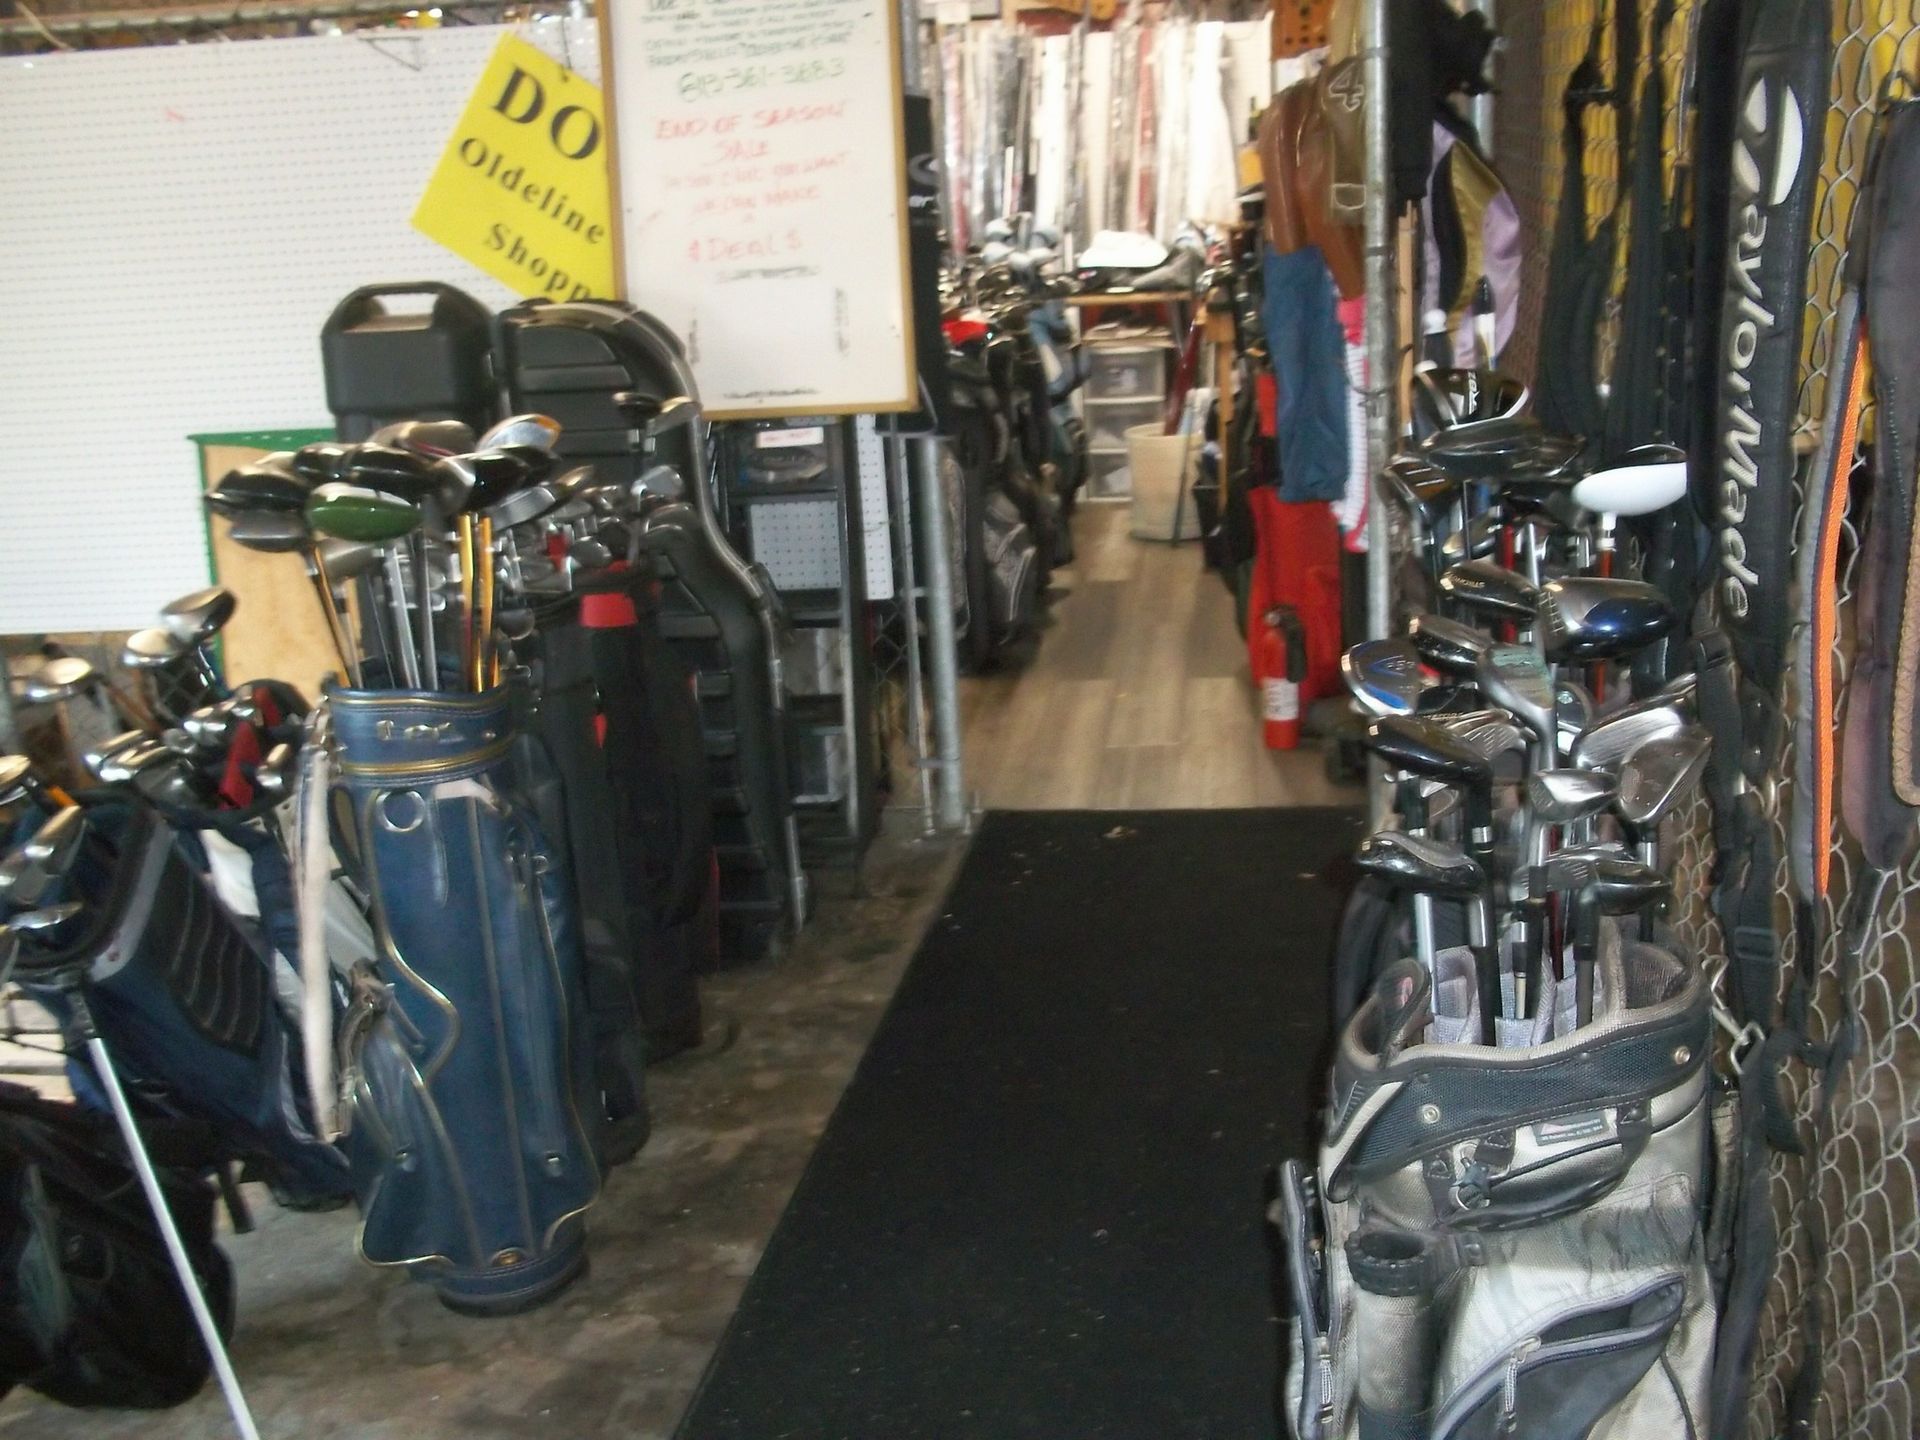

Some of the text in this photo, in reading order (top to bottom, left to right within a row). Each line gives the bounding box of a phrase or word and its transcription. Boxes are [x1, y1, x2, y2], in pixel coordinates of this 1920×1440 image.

[493, 63, 601, 161] DO
[713, 114, 743, 134] OF
[459, 138, 604, 244] Oldeline
[1720, 76, 1803, 618] TaylorMade
